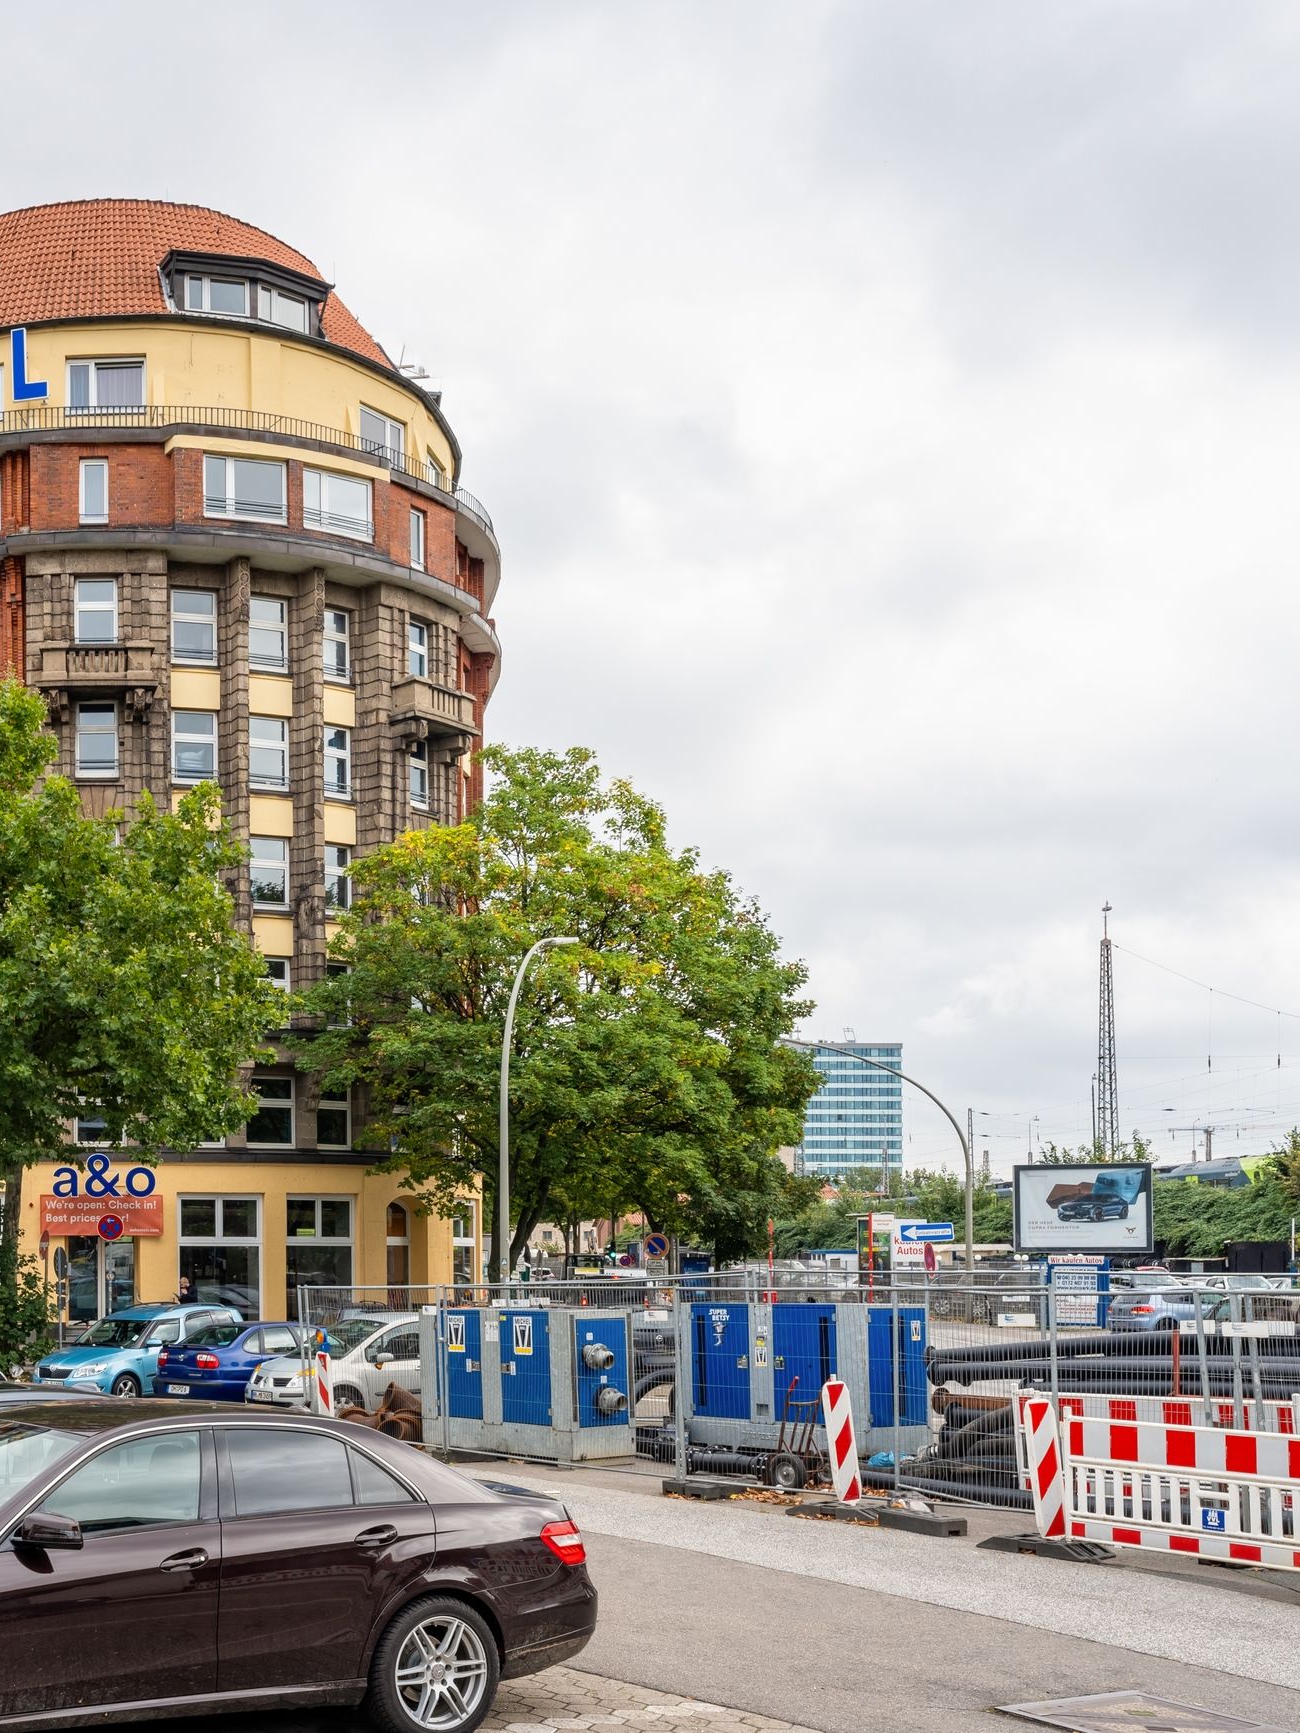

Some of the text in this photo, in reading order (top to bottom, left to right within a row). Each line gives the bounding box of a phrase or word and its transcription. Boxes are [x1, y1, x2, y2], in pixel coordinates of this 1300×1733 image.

[52, 1153, 156, 1198] a&o
[46, 1200, 157, 1211] We're open: Check in!
[45, 1214, 70, 1222] Best
[896, 1246, 924, 1255] Autos
